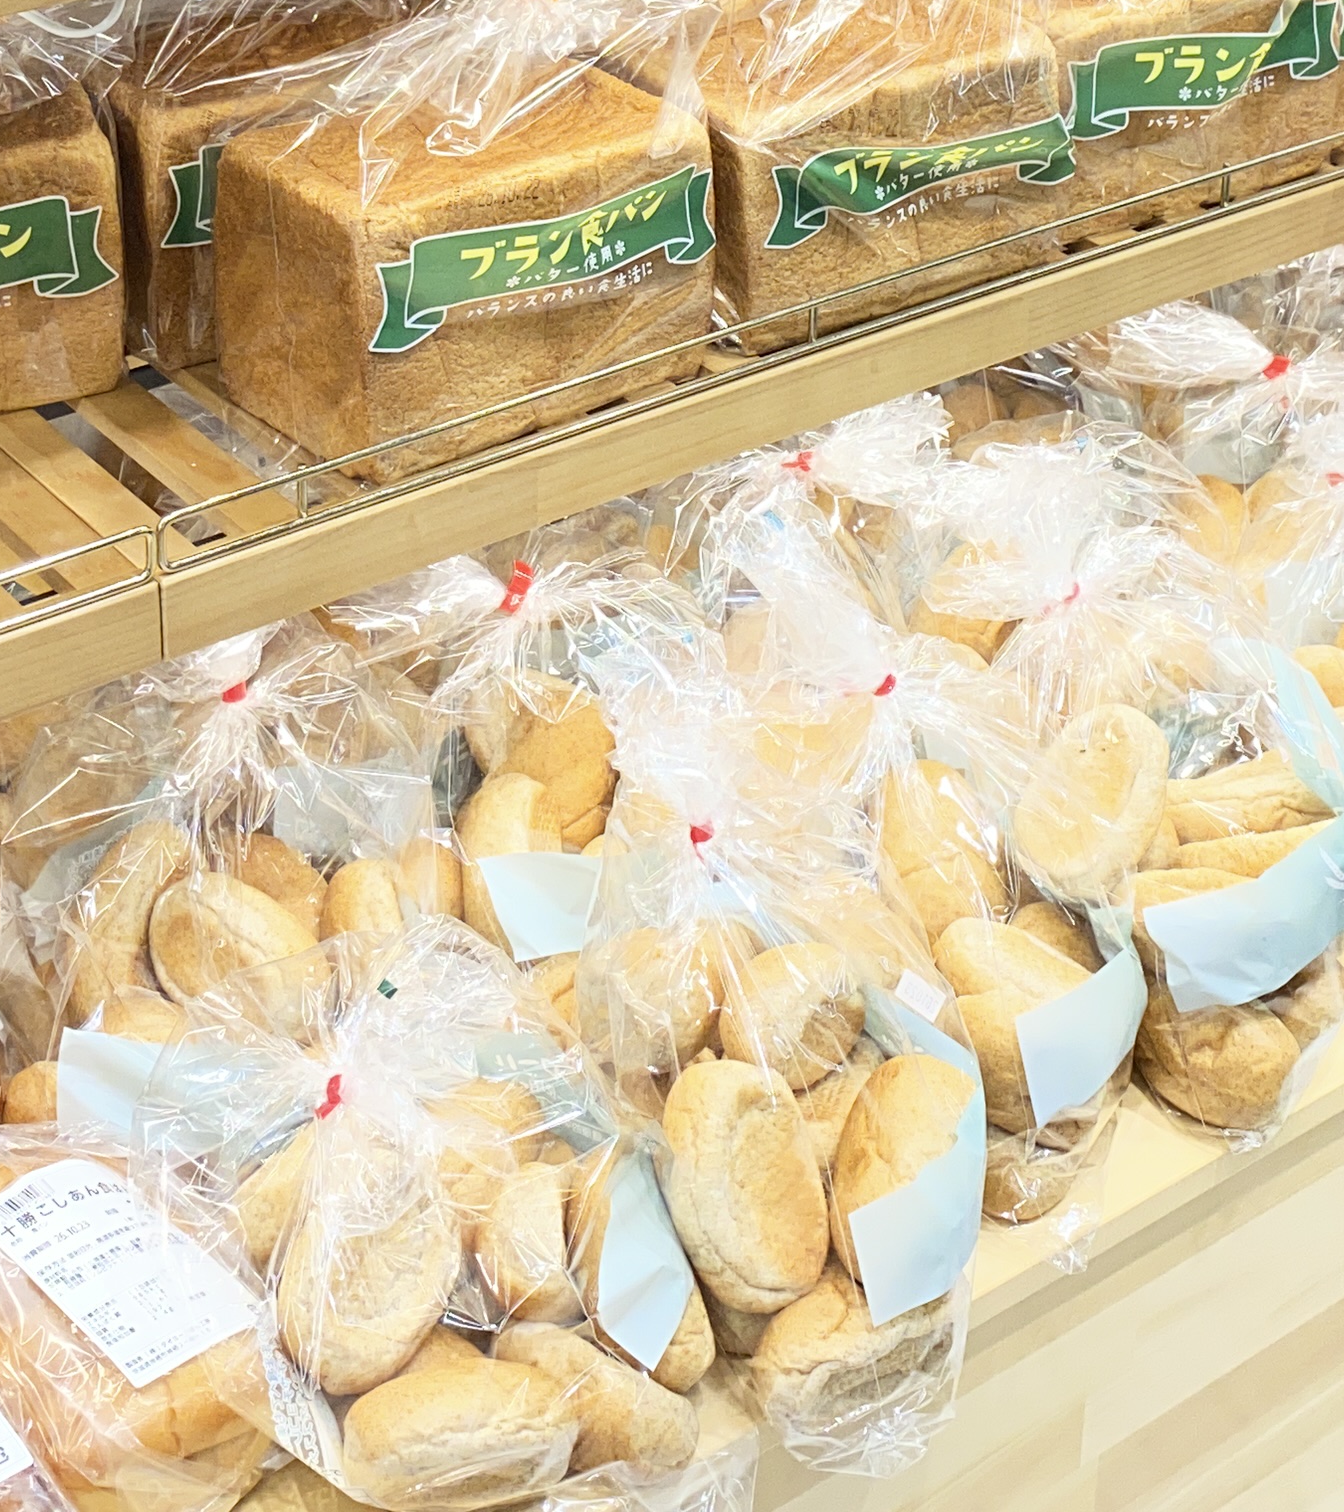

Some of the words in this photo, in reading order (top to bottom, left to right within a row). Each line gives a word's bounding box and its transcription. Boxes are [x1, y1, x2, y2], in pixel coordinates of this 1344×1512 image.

[460, 190, 667, 281] ブラン食パン
[523, 240, 611, 286] バター使用
[467, 262, 654, 320] バランスの良い食生活に
